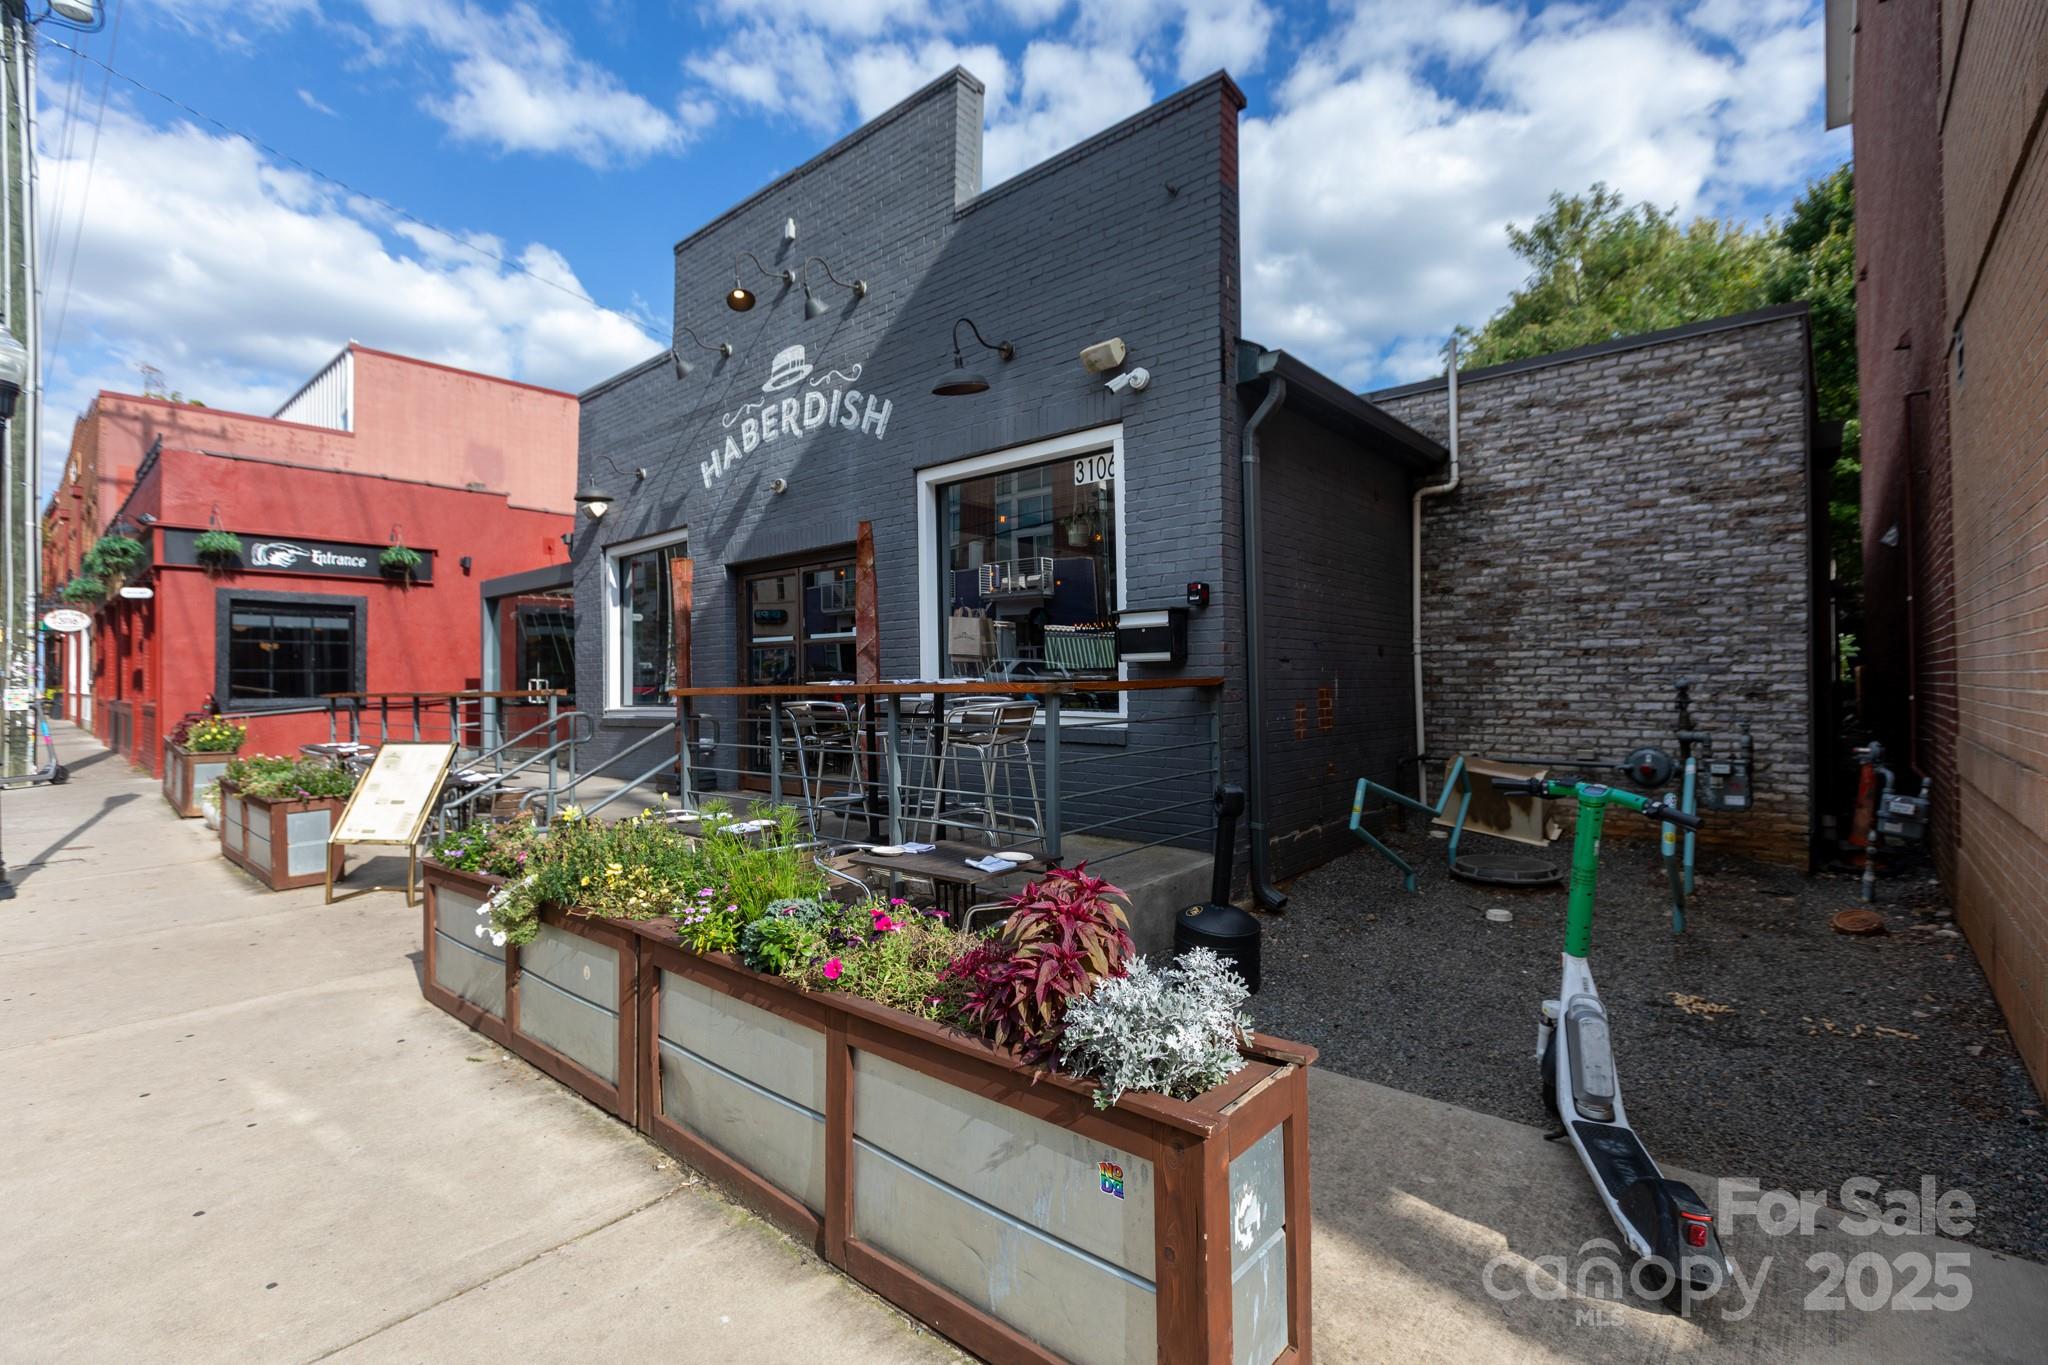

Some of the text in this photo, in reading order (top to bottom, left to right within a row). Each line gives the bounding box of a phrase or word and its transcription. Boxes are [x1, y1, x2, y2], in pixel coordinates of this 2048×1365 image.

[700, 389, 894, 489] HABERDISH
[1075, 454, 1115, 484] 3106
[311, 548, 368, 568] Entrance
